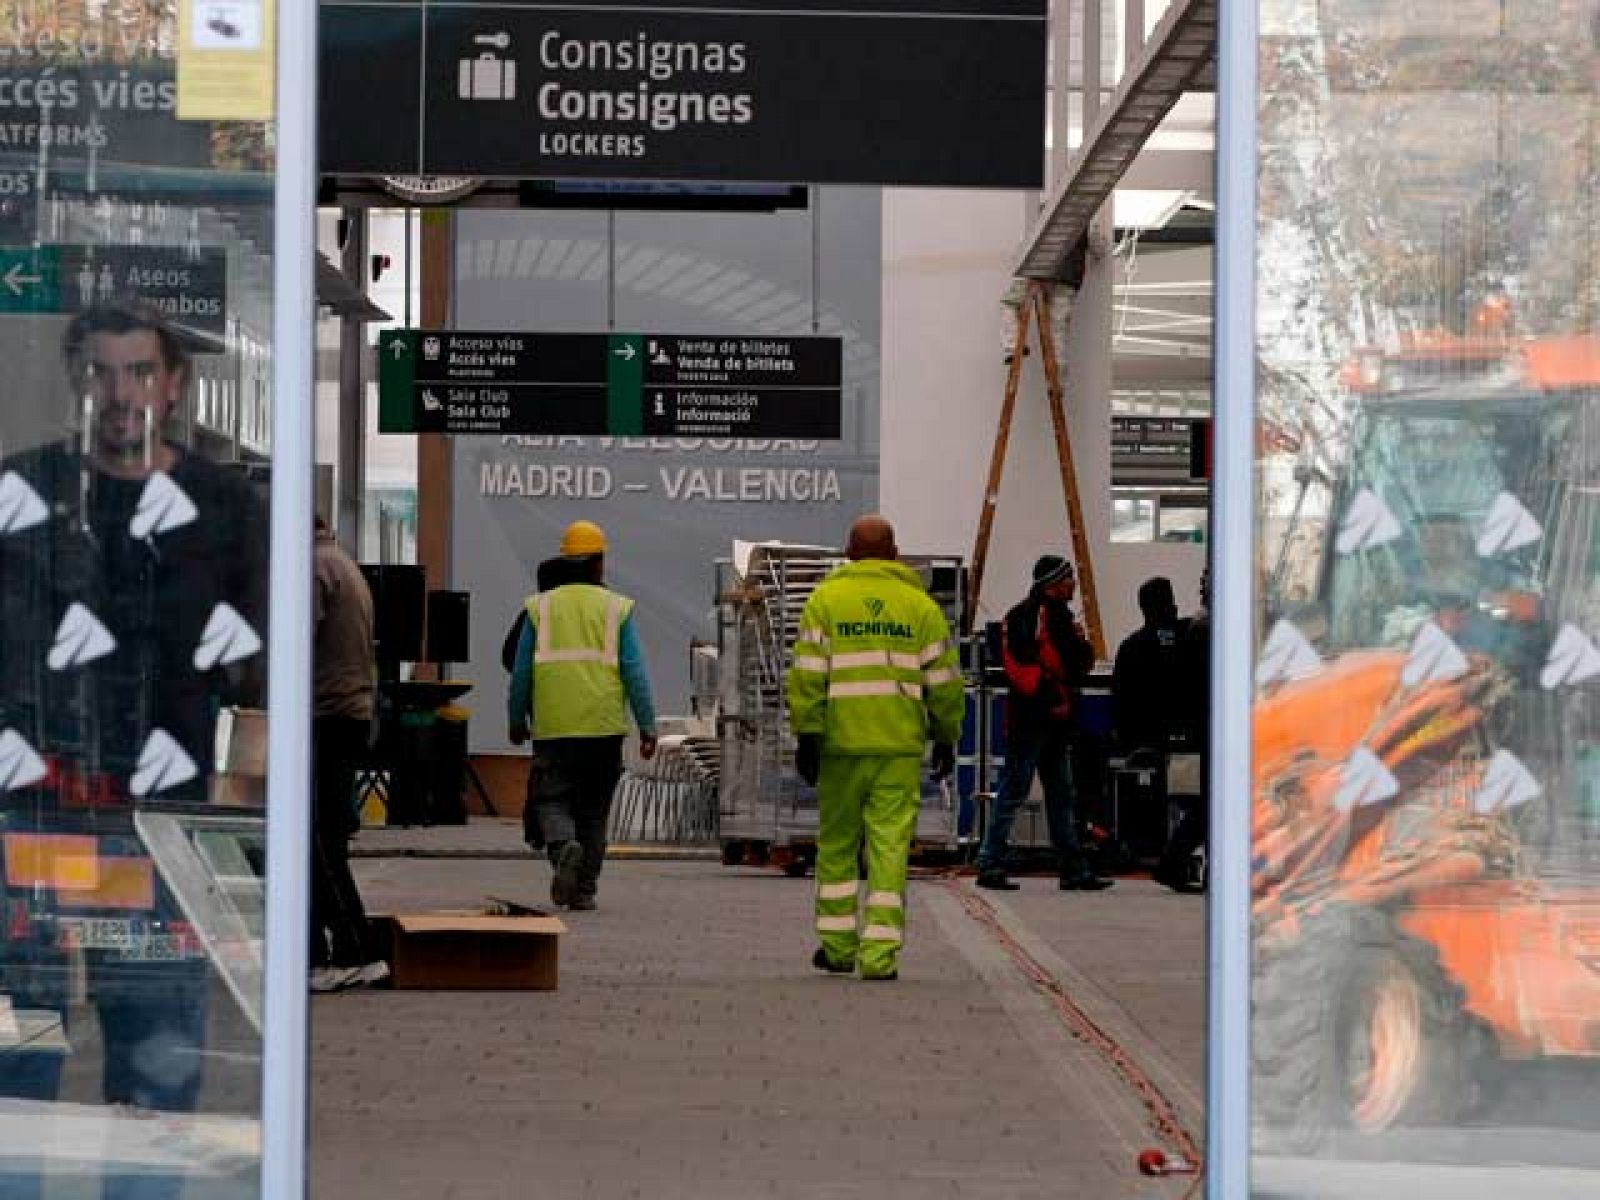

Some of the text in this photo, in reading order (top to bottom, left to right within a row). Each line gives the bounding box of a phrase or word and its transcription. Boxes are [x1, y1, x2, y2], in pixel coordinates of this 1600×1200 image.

[540, 31, 746, 79] Consignas
[93, 71, 176, 110] vies
[538, 81, 751, 130] Consignes
[540, 133, 646, 156] LOCKERS
[127, 265, 191, 288] Aseos
[719, 339, 736, 354] de
[724, 355, 741, 370] de
[480, 462, 612, 499] MADRID
[659, 466, 842, 502] VALENCIA
